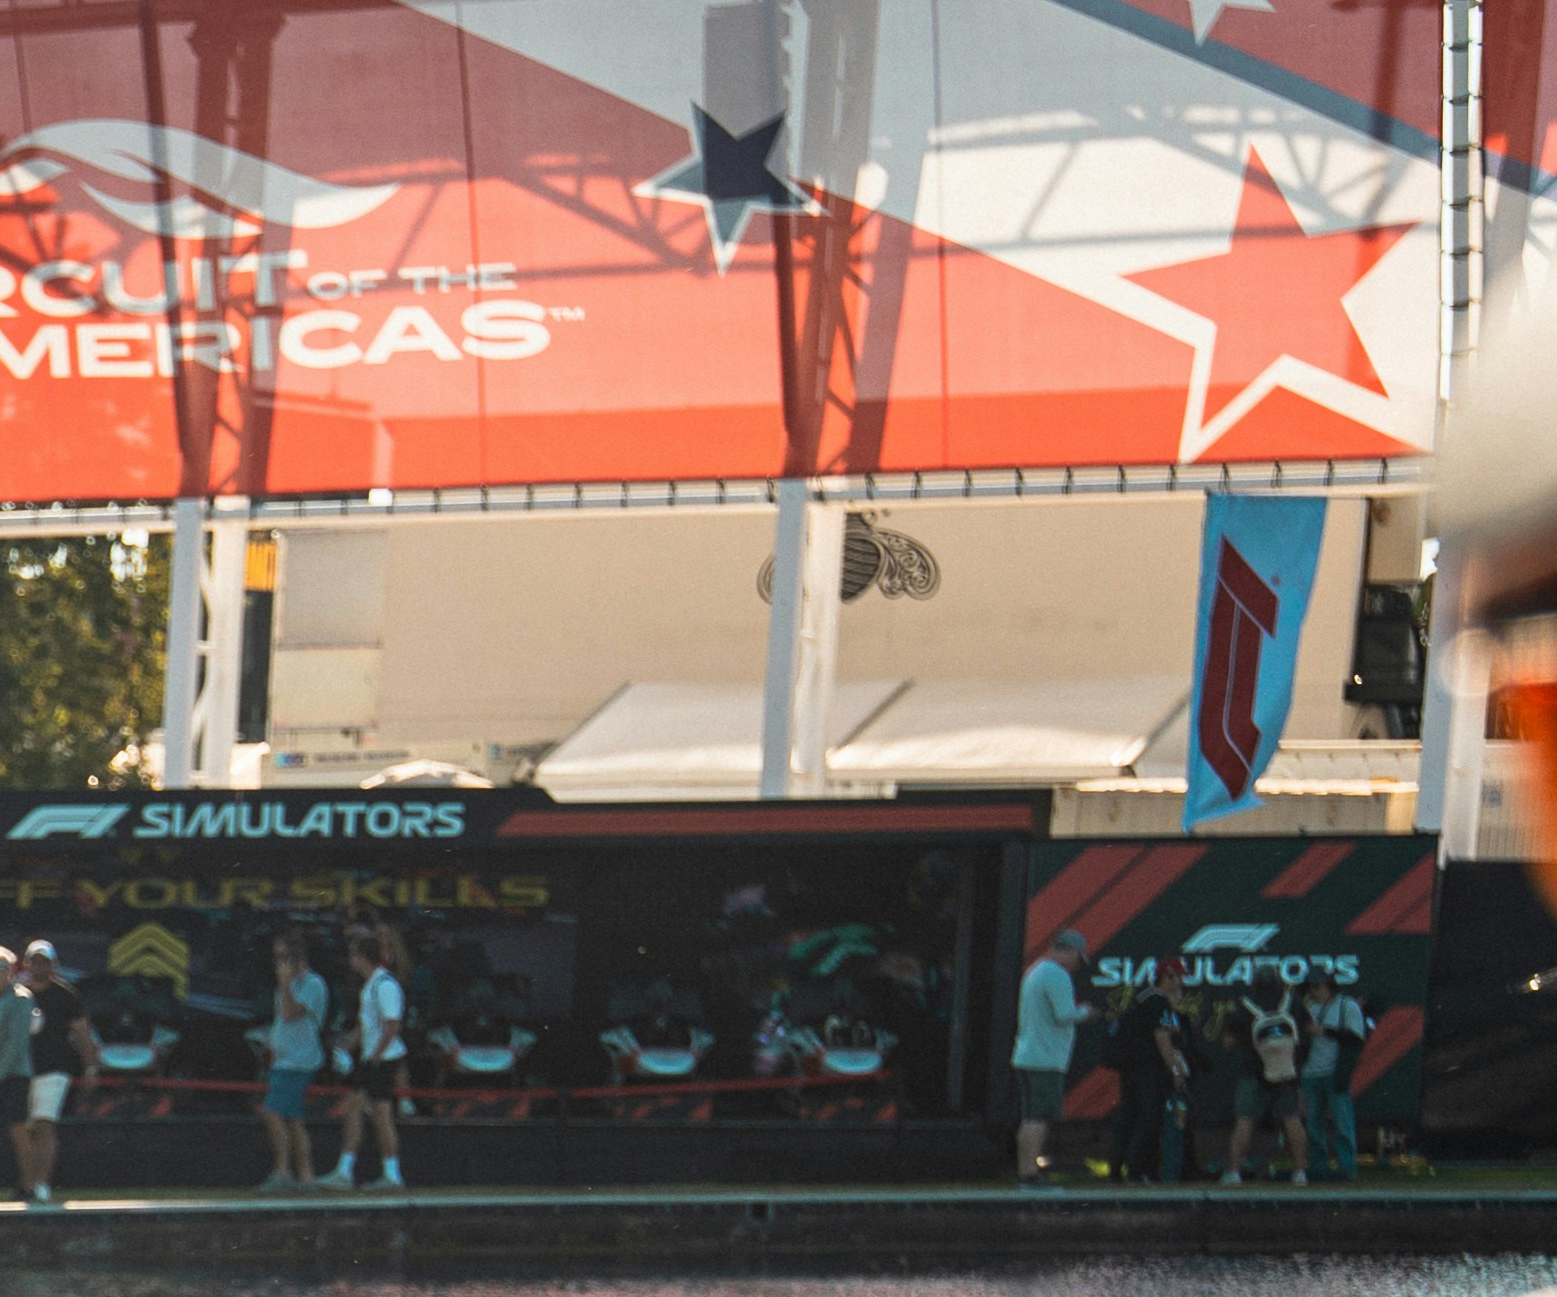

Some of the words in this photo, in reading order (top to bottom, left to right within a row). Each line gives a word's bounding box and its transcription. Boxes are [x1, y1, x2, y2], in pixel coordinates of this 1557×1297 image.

[307, 267, 387, 301] OF
[398, 261, 517, 295] THE
[6, 804, 131, 840] F1
[132, 801, 467, 840] SIMULATORS
[77, 876, 276, 911] YOUR
[288, 874, 550, 909] SKILLS
